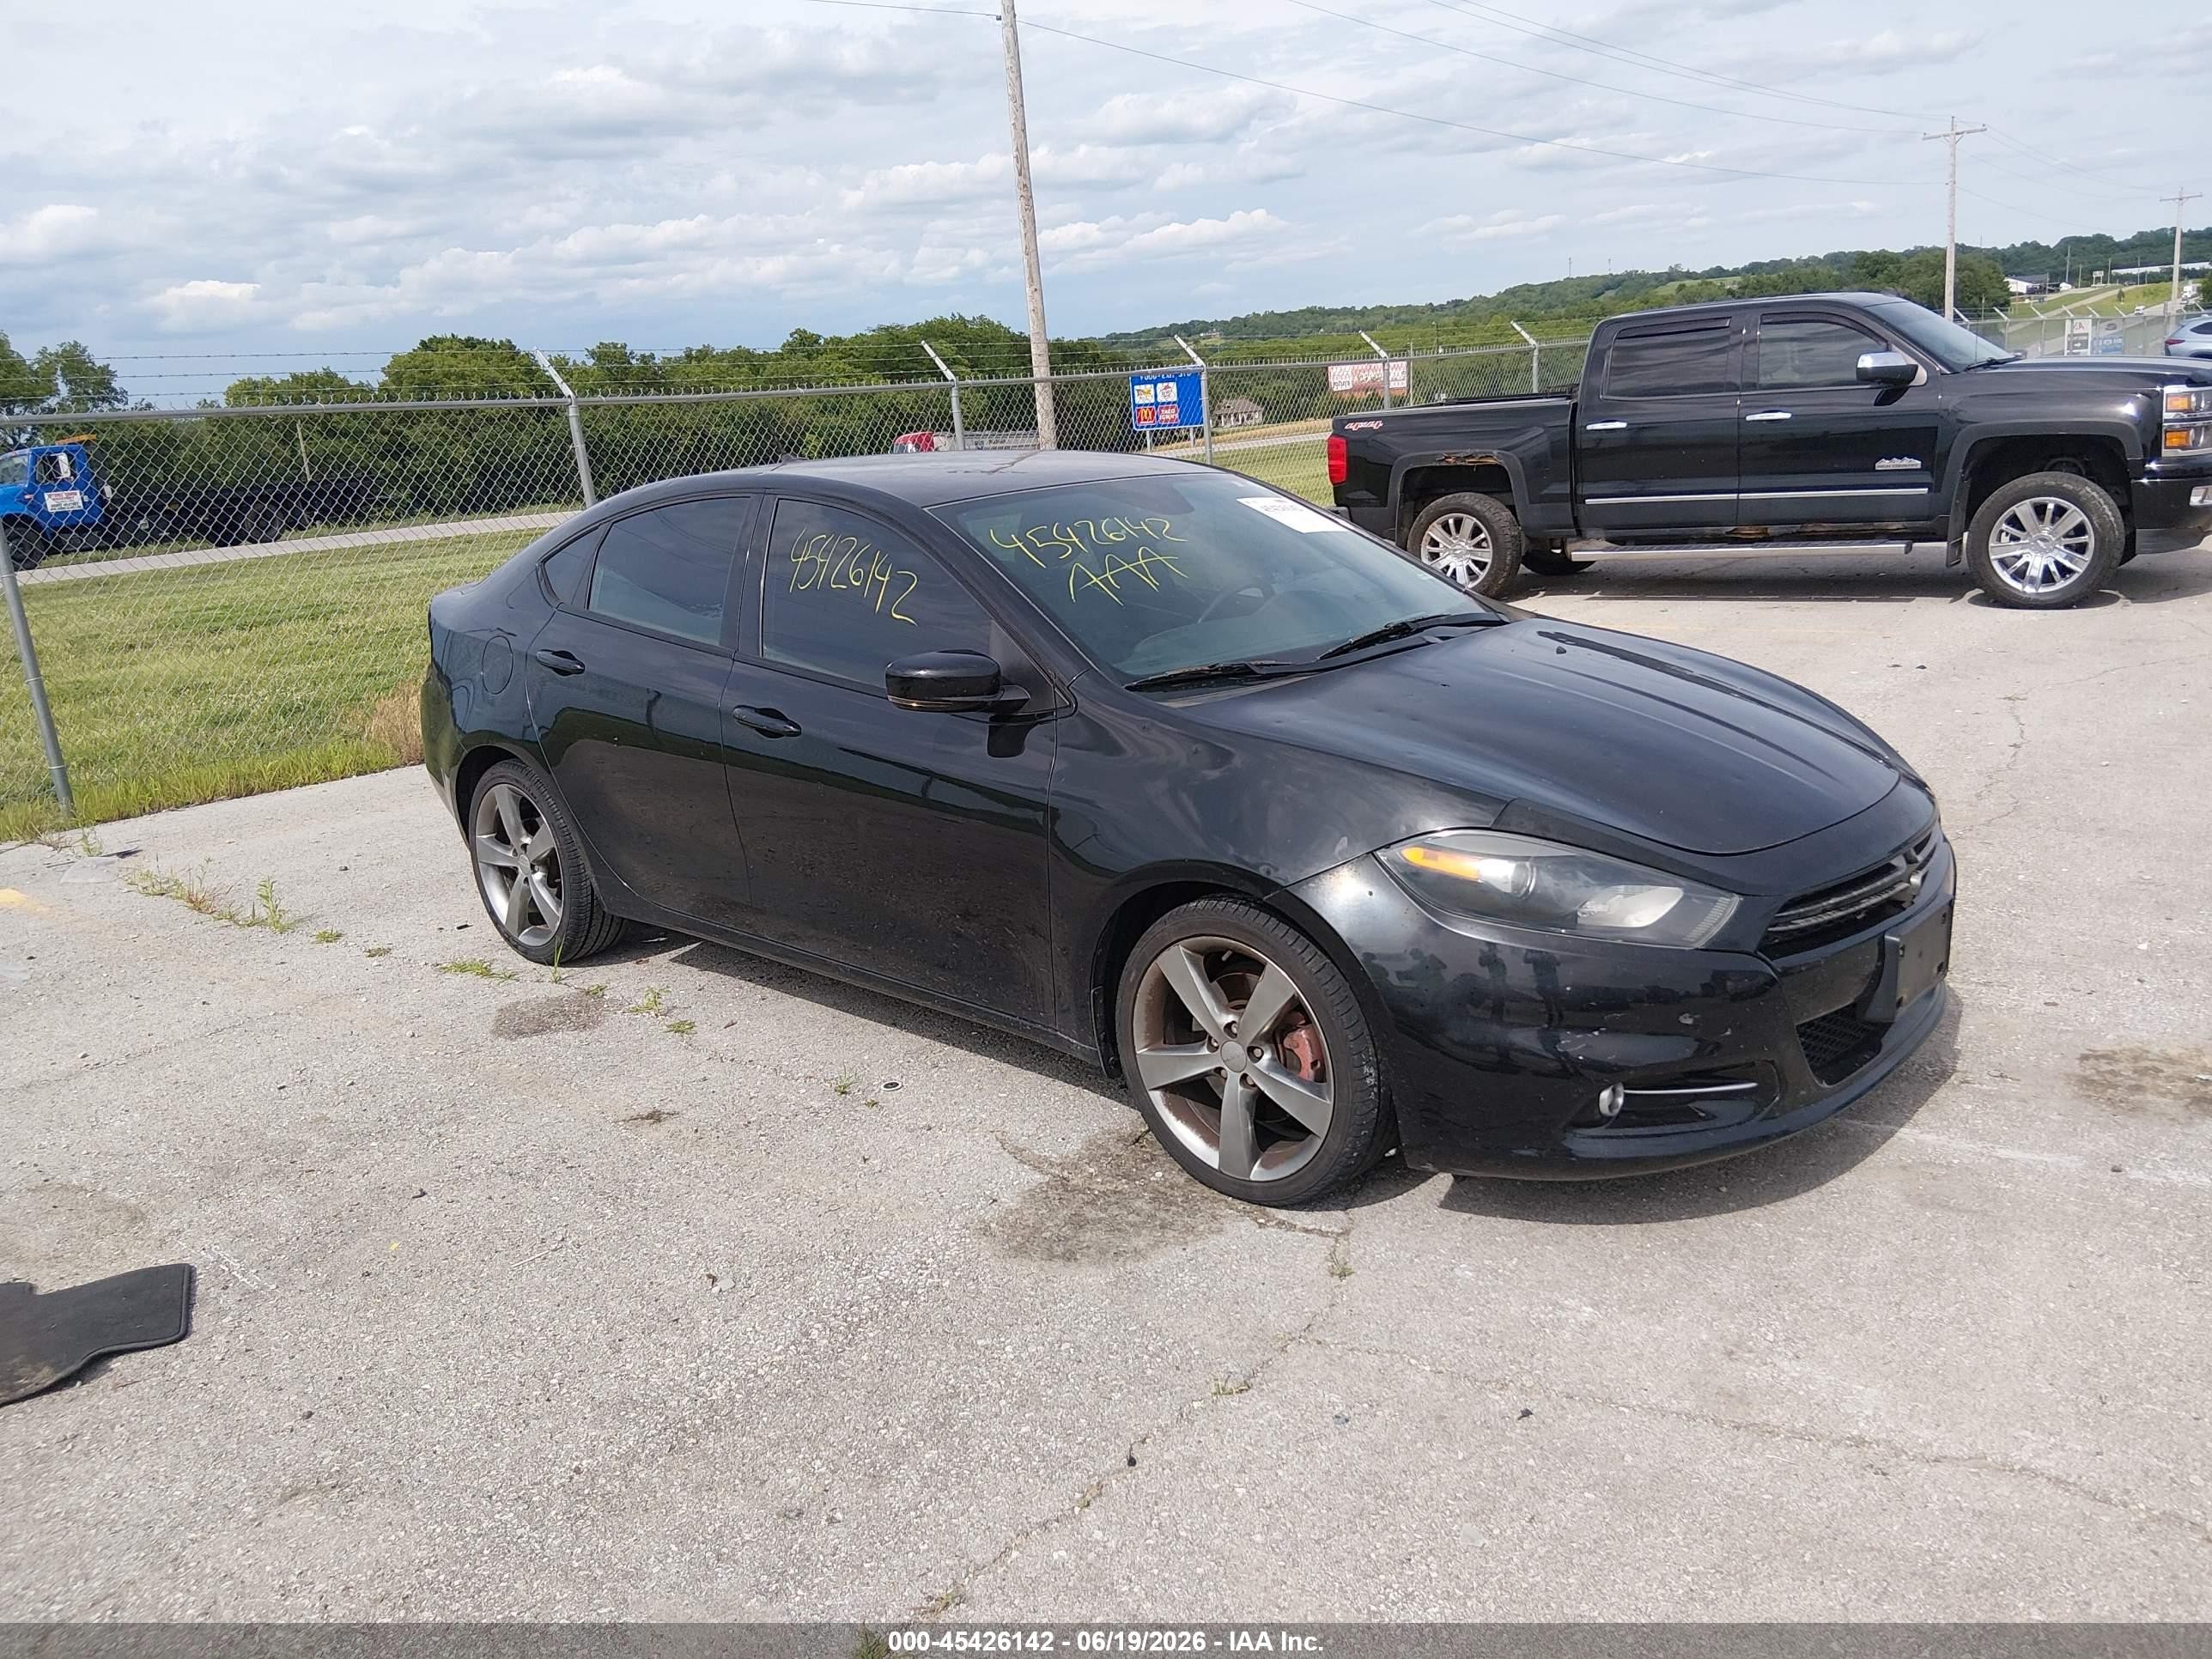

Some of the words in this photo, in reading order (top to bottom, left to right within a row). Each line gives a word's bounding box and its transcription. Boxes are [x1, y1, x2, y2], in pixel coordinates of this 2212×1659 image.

[990, 517, 1188, 568] 45426142
[790, 526, 918, 627] 45426142
[1068, 545, 1189, 607] AAA
